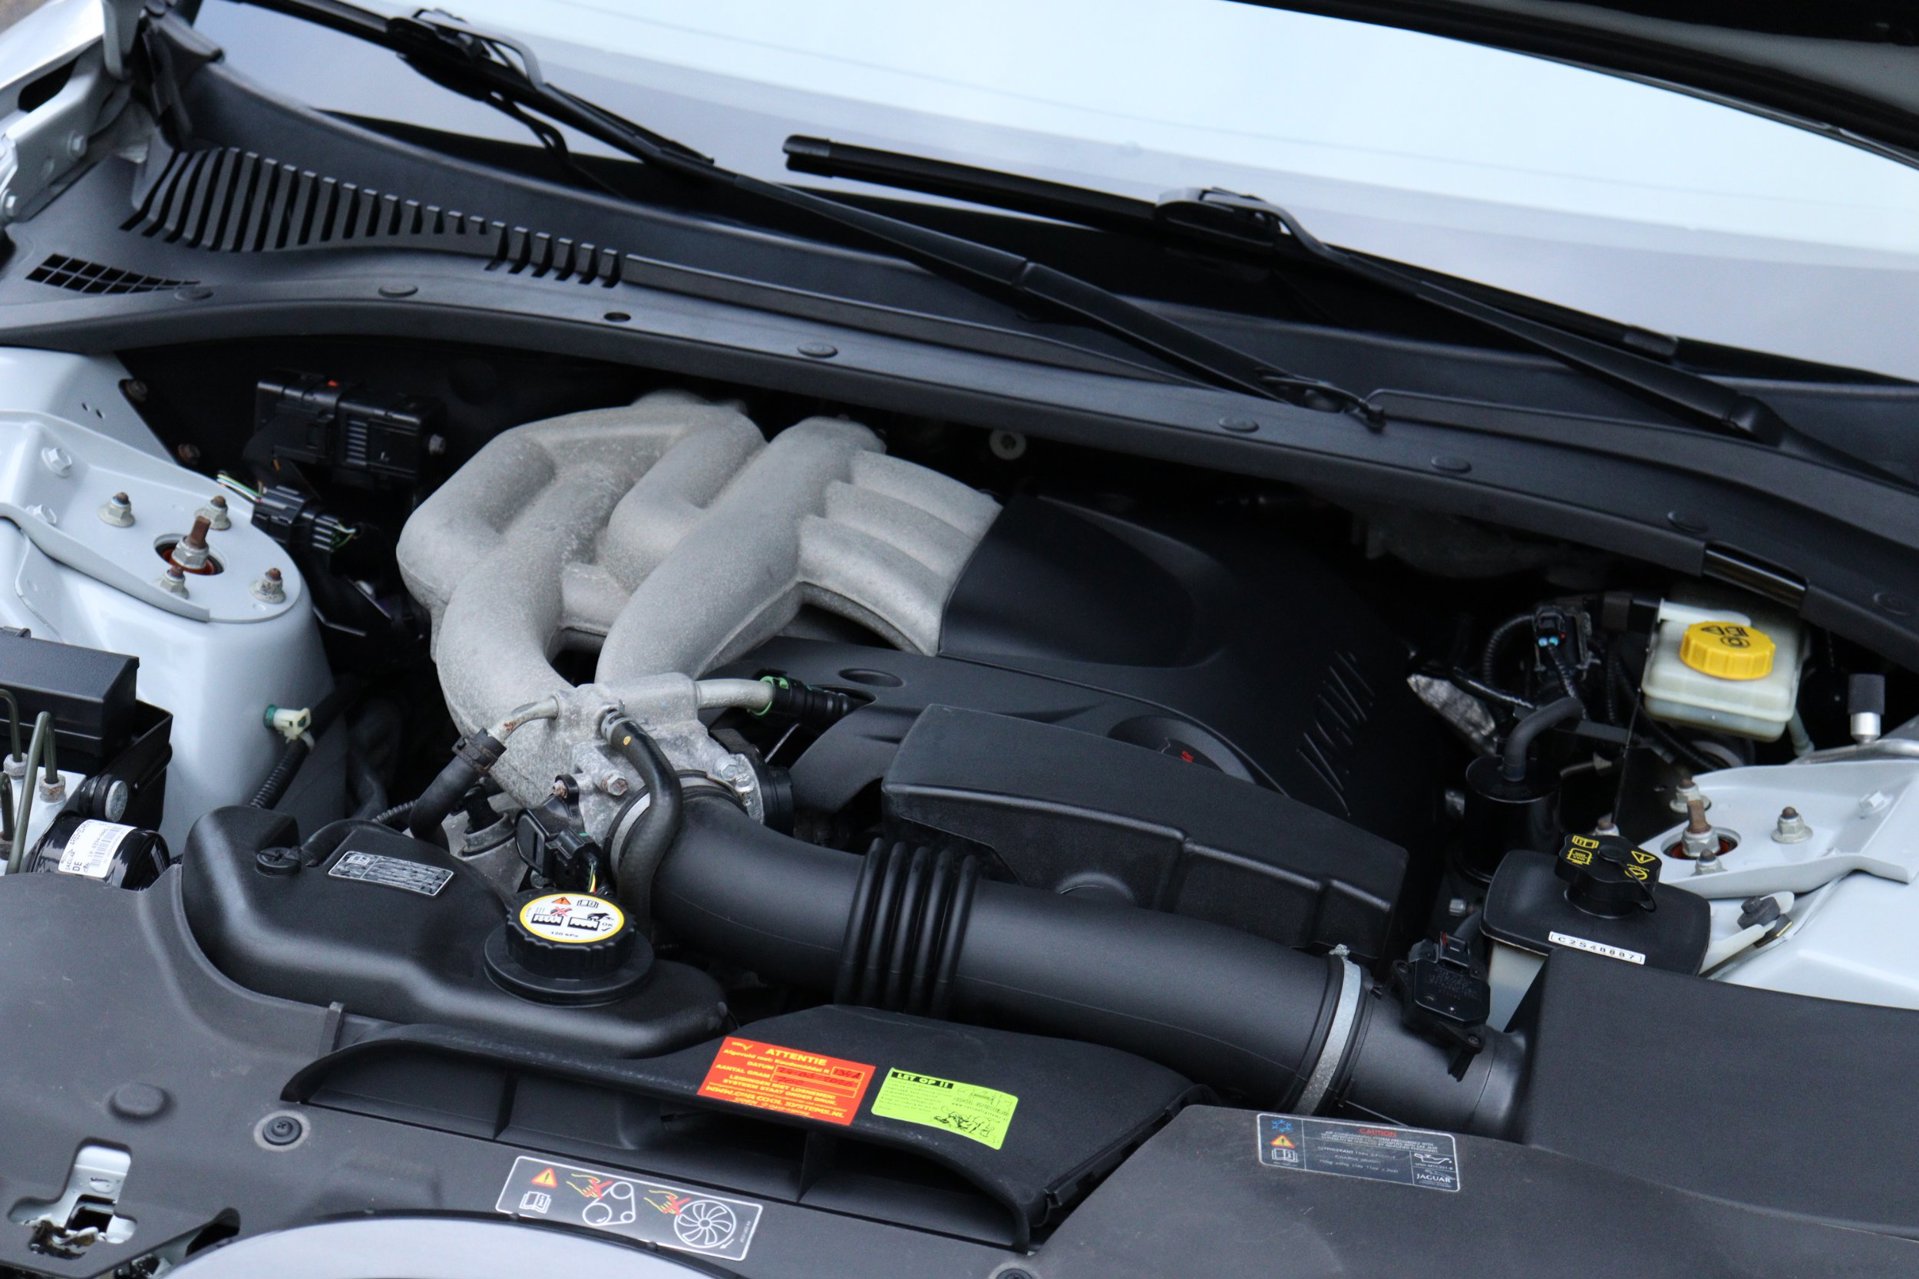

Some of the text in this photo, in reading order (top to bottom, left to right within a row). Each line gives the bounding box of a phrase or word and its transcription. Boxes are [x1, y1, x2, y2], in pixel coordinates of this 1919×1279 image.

[765, 1048, 827, 1066] ATTENTIE
[715, 1063, 771, 1078] AANTAL GRAM
[747, 1060, 774, 1070] DATUM
[897, 1072, 915, 1082] LET
[918, 1077, 936, 1086] OP
[722, 1078, 759, 1090] SYSTEEM
[760, 1085, 784, 1094] STAAT
[784, 1091, 813, 1101] ONDER
[771, 1082, 789, 1090] NIET
[1358, 1127, 1397, 1138] CAUTION
[1416, 1173, 1451, 1184] JAGUAR
